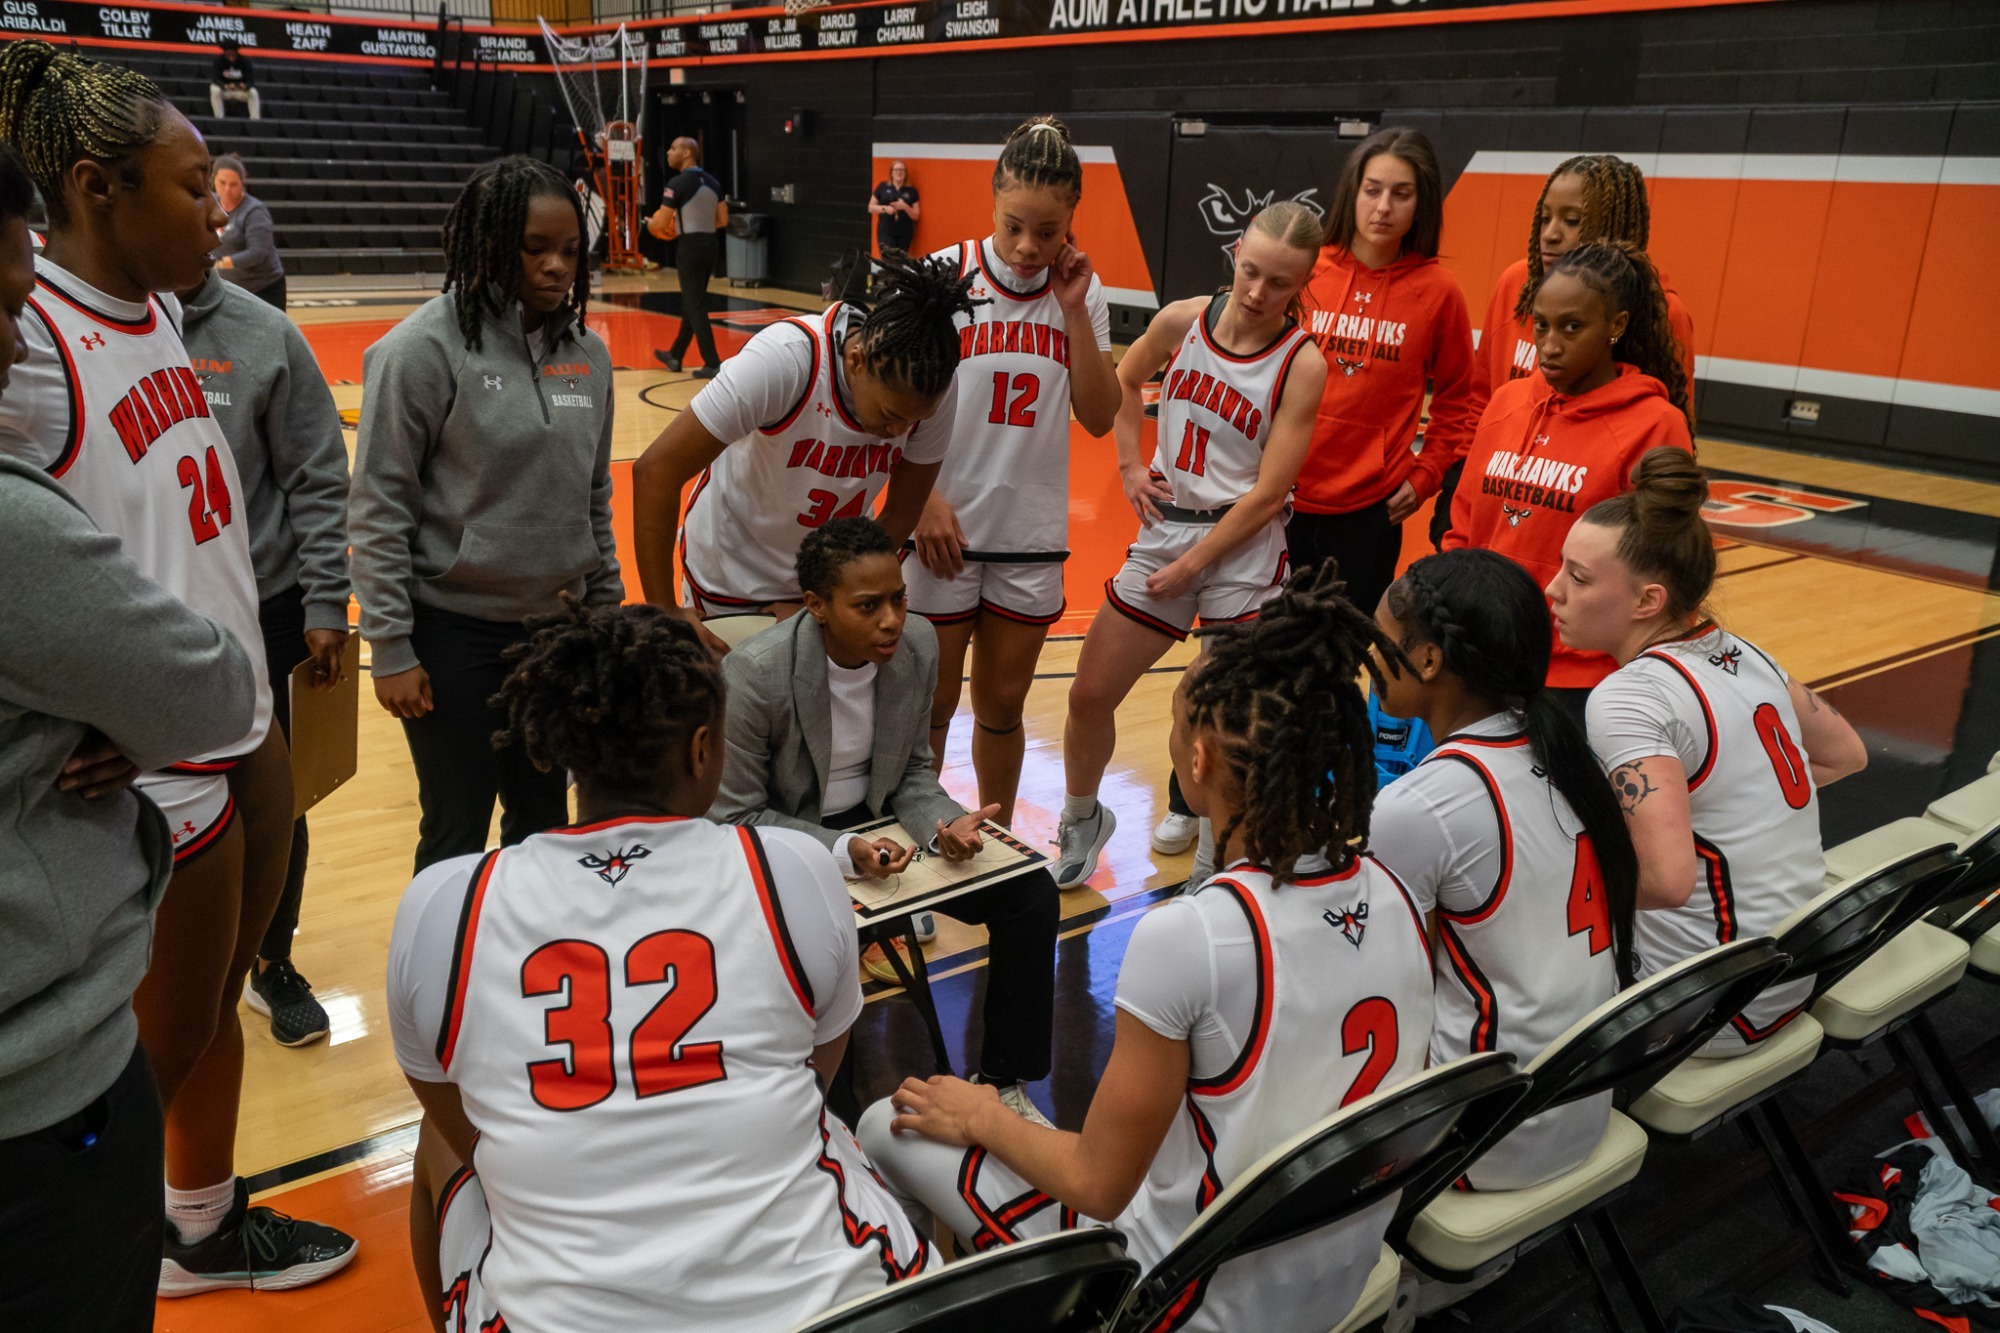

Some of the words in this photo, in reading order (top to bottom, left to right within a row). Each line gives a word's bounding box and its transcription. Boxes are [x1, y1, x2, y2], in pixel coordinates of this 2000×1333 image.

[3, 1, 38, 16] GUS
[99, 7, 150, 24] COLBY
[884, 7, 917, 25] LARRY
[956, 1, 988, 19] LEIGH
[1049, 0, 1108, 29] AUM
[196, 15, 245, 32] JAMES
[285, 21, 331, 38] HEATH
[767, 20, 782, 34] DR.
[782, 18, 797, 32] JIM
[820, 13, 856, 30] DAROLD
[945, 18, 1000, 38] SWANSON
[101, 23, 151, 39] TILLEY
[186, 28, 217, 43] VAN
[377, 28, 427, 44] MARTIN
[660, 28, 681, 42] KATIE
[700, 24, 719, 39] RANK
[818, 30, 857, 47] DUNLAVY
[877, 24, 924, 43] CHAPMAN
[291, 36, 328, 50] ZAPF
[361, 41, 437, 58] GUSTAVSSO
[479, 36, 527, 50] BRANDI
[656, 42, 686, 57] BARNETT
[709, 39, 738, 53] WILSON
[764, 33, 802, 49] WILLIAMS
[190, 357, 232, 373] UM
[543, 363, 591, 377] AUM
[551, 394, 594, 408] BASKETBALL
[988, 371, 1040, 428] 12
[1175, 418, 1211, 478] 11
[1485, 450, 1588, 494] WARHAWKS
[176, 444, 232, 546] 24
[1482, 477, 1576, 513] BASKETBALL
[1753, 702, 1811, 810] 0
[980, 825, 1035, 856] HAWKS
[1566, 832, 1611, 957] 4
[520, 927, 728, 1113] 32
[1341, 996, 1399, 1109] 2
